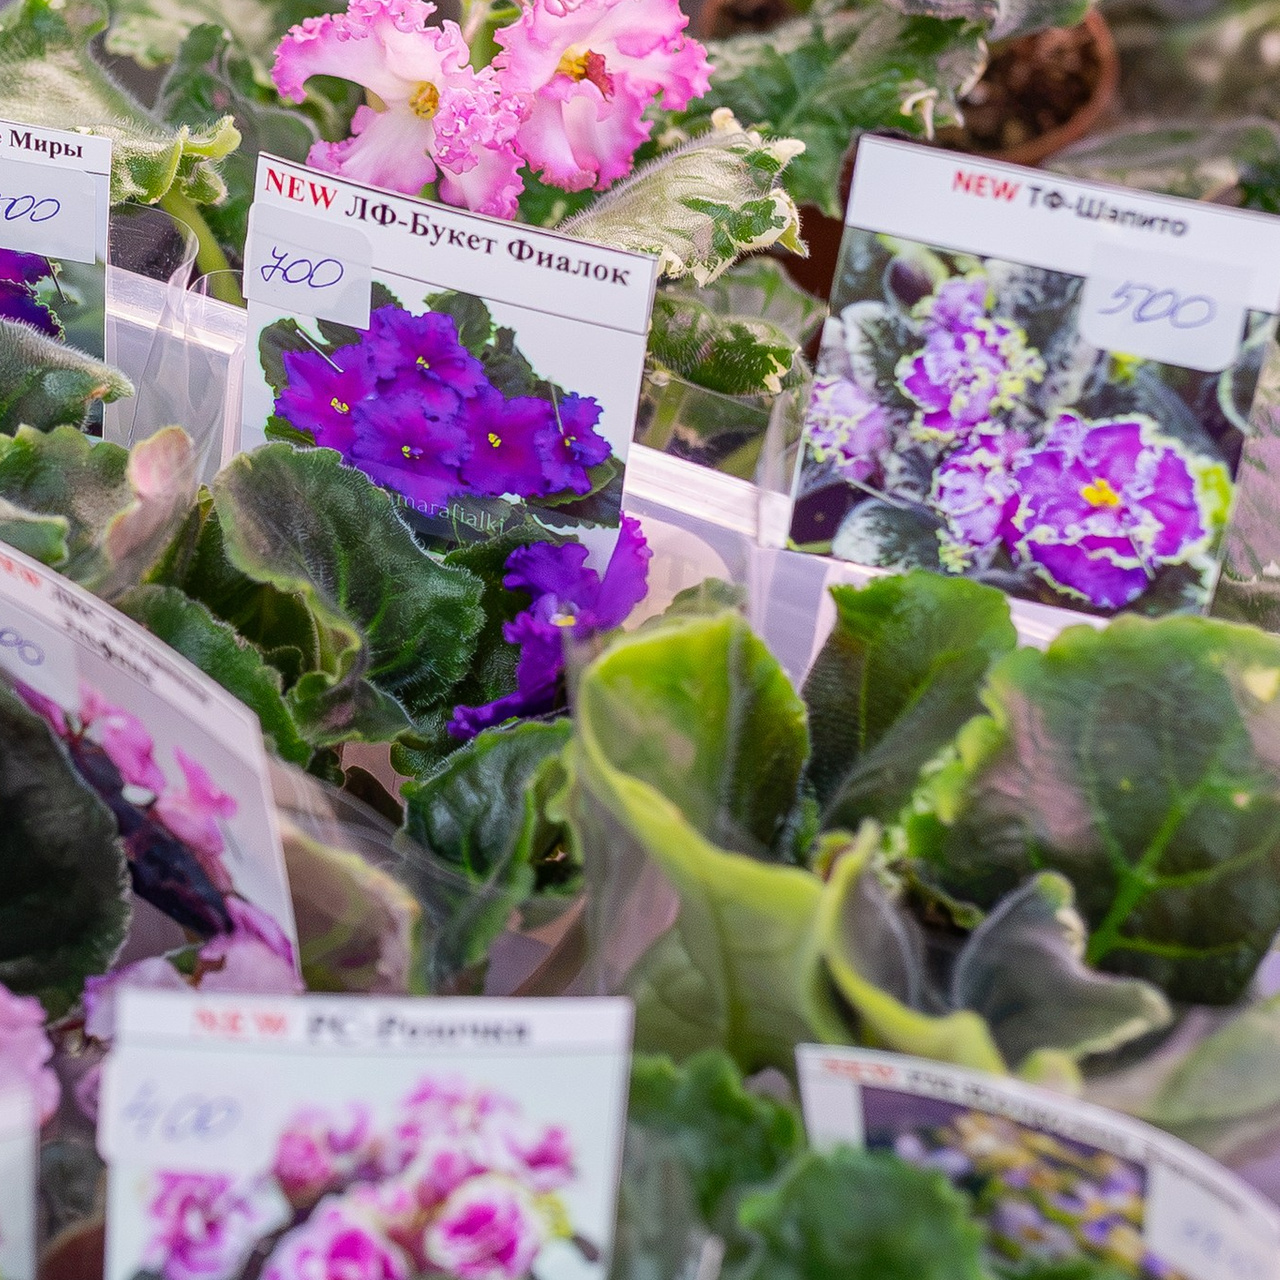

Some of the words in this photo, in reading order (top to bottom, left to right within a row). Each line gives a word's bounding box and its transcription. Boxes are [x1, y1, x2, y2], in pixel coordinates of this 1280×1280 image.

[8, 128, 84, 160] Миры
[951, 168, 1021, 203] NEW
[264, 167, 338, 211] NEW
[344, 195, 498, 256] ЛФ-Букет
[507, 237, 632, 287] Фиалок
[1096, 280, 1218, 329] 500
[192, 1006, 292, 1037] NEW
